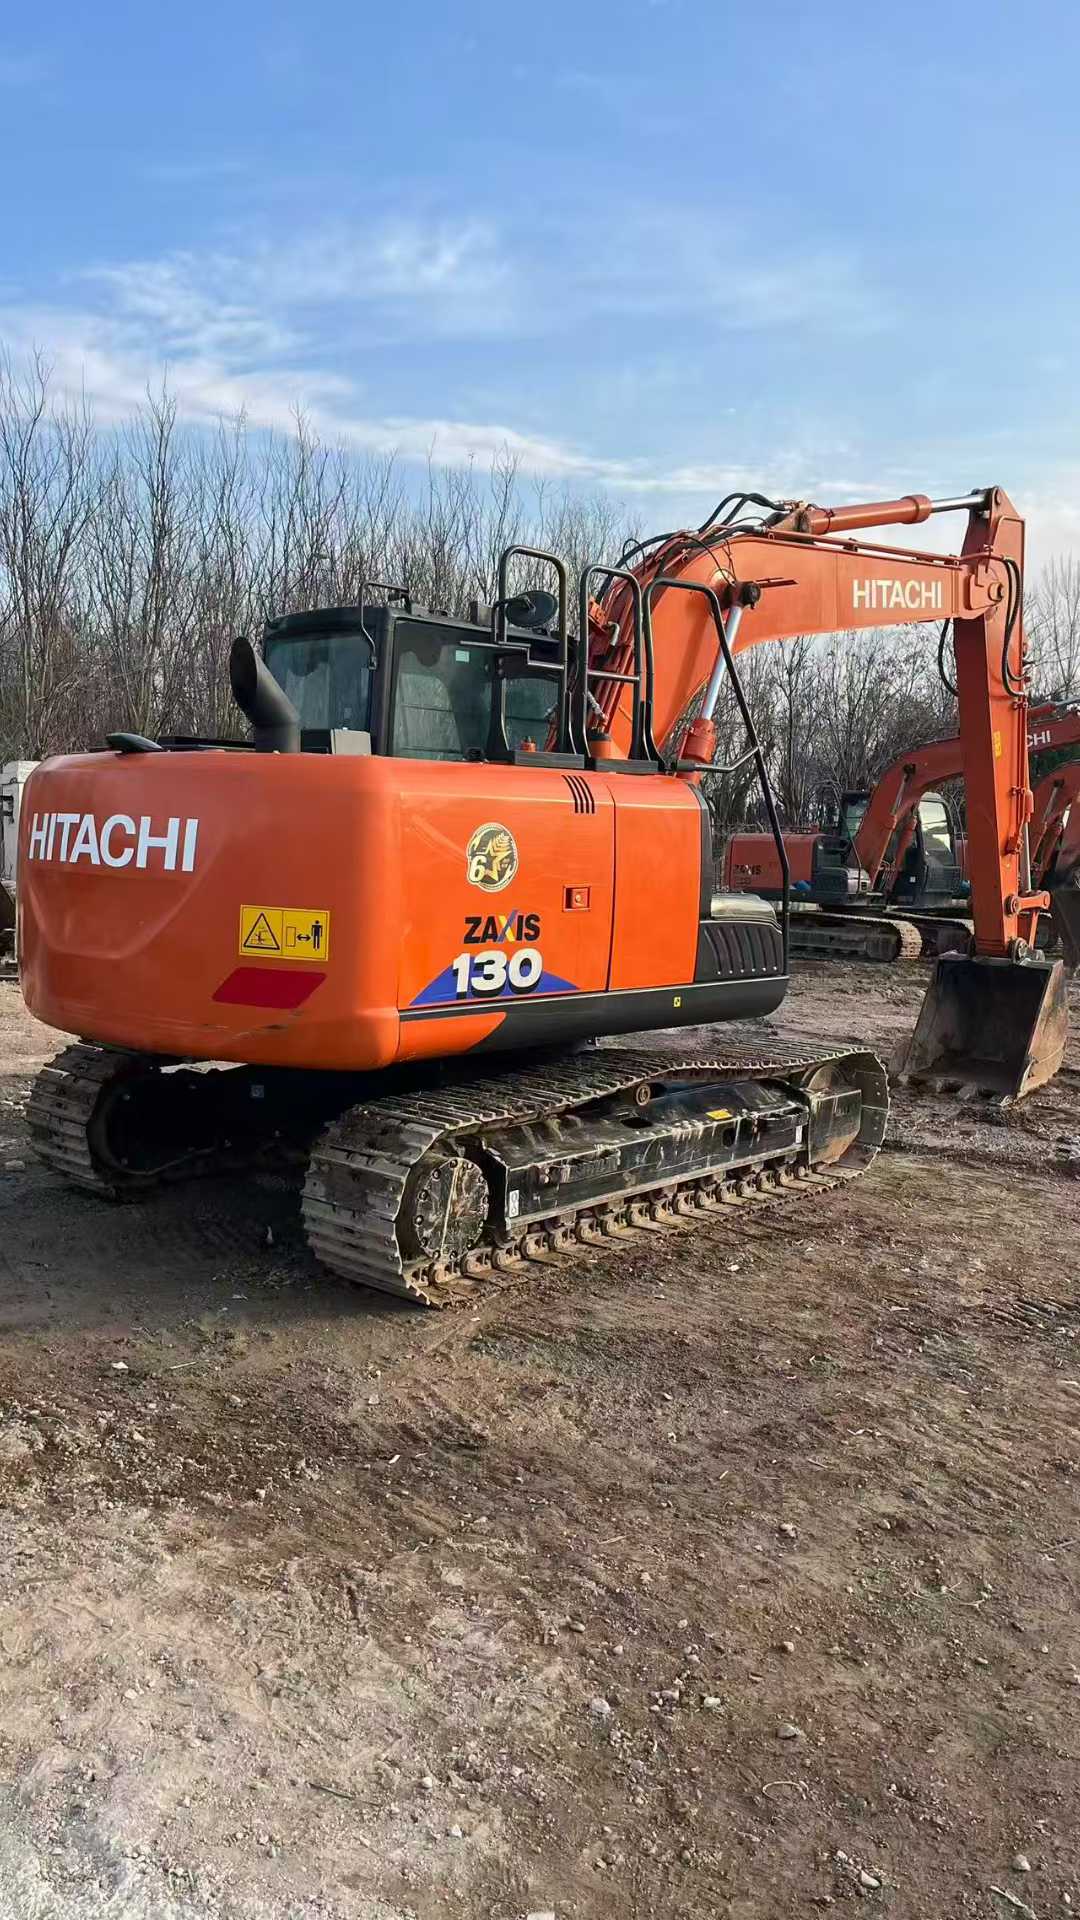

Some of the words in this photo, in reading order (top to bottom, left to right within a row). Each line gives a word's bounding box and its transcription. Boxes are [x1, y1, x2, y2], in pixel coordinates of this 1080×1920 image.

[853, 579, 942, 608] HITACHI
[29, 813, 199, 872] HITACHI
[463, 909, 541, 944] ZAXIS
[452, 948, 544, 999] 130
